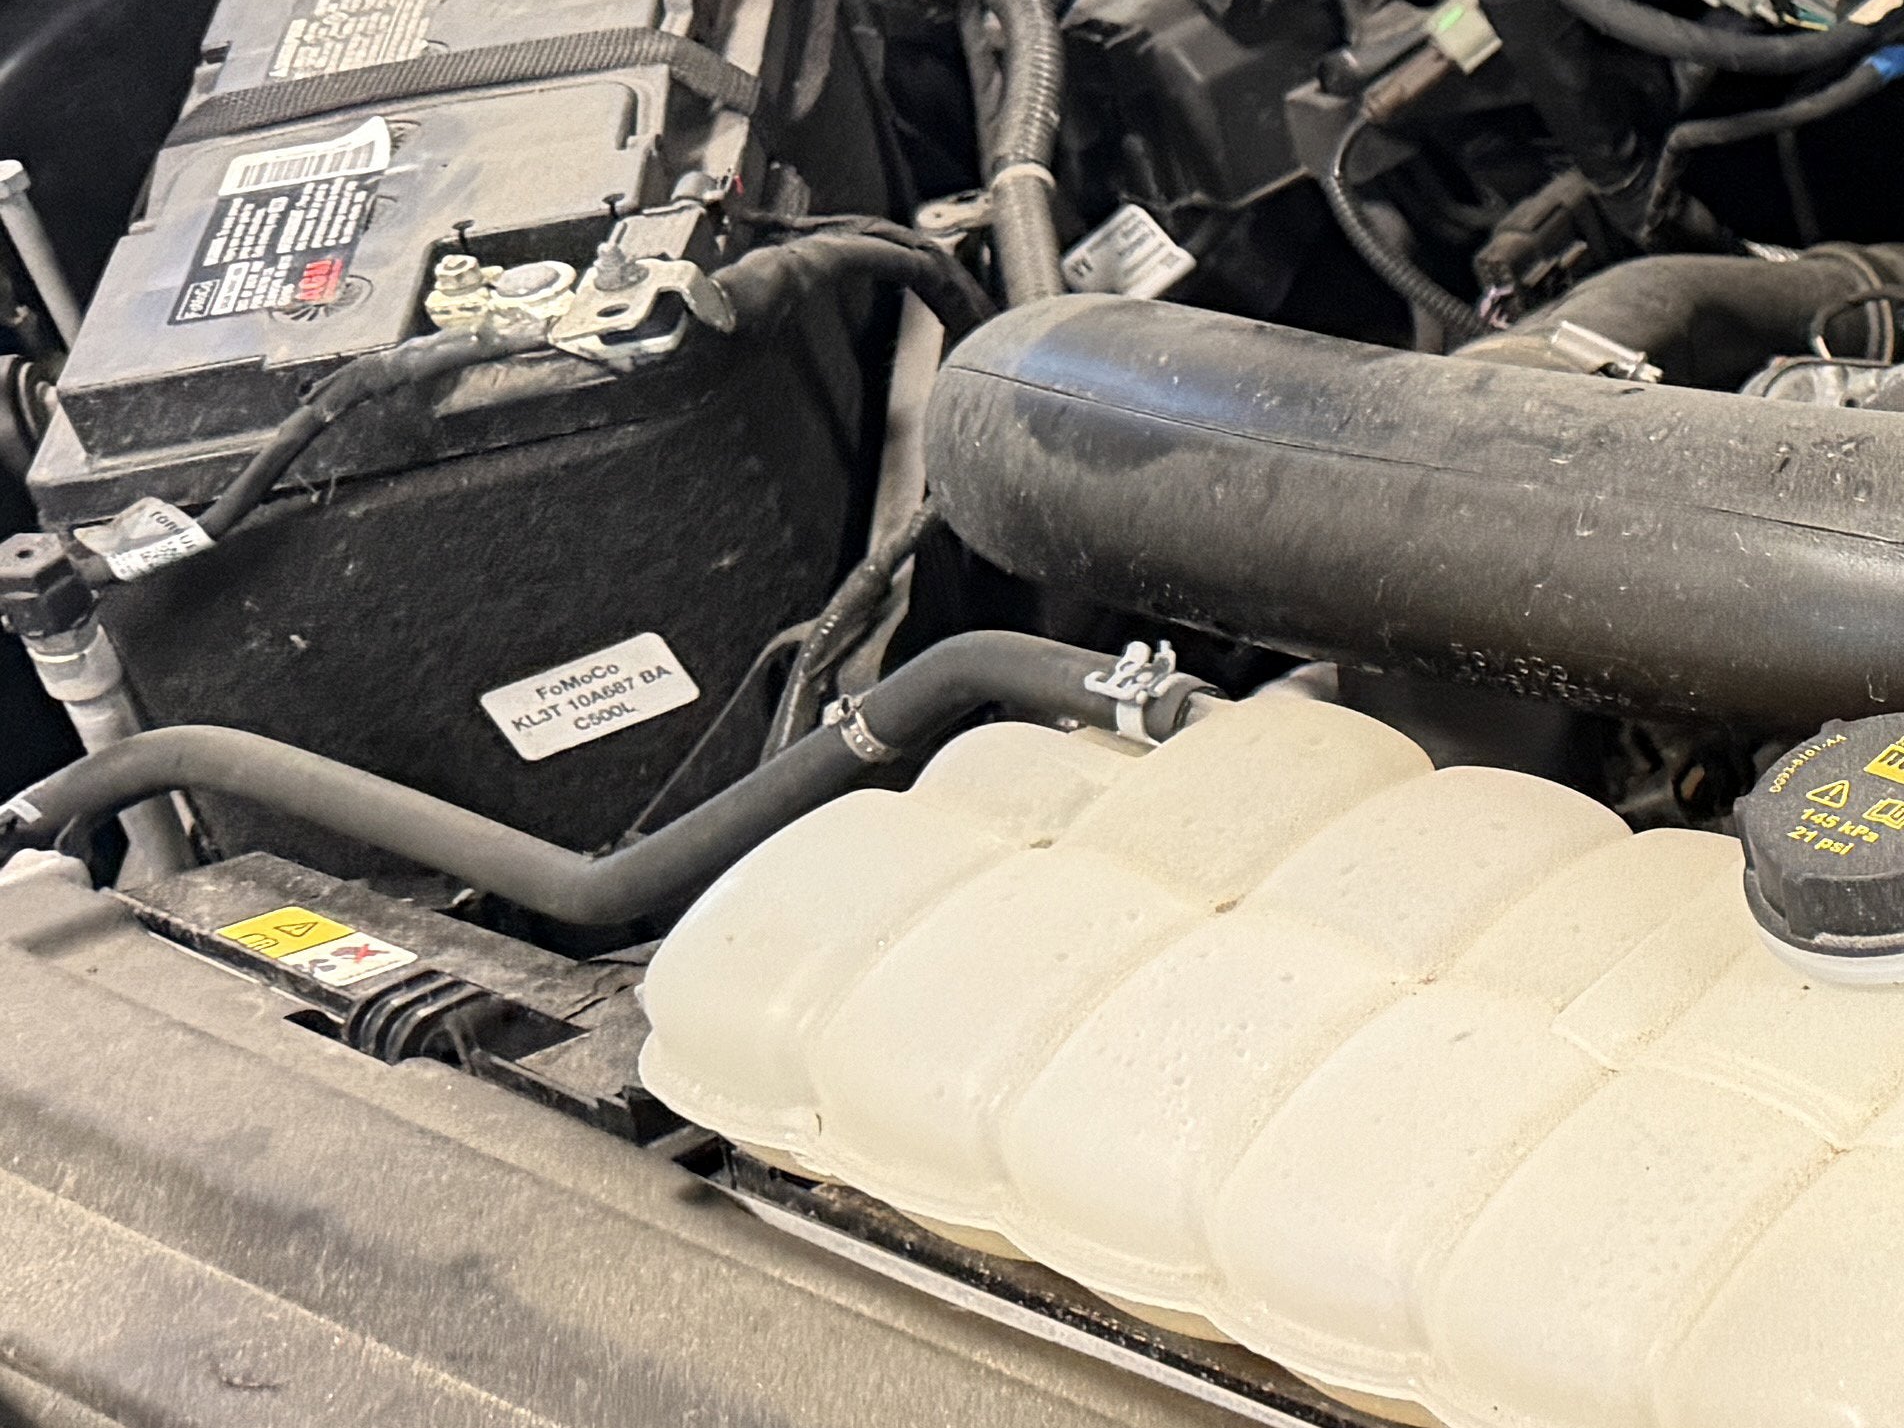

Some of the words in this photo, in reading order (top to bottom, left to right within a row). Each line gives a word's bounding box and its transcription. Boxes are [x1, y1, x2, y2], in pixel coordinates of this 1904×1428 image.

[535, 662, 620, 701] FoMoCo
[510, 703, 562, 732] KL3T
[1786, 825, 1819, 843] 21
[1813, 837, 1855, 856] psi
[1800, 807, 1841, 829] 145
[1837, 820, 1880, 844] kPa
